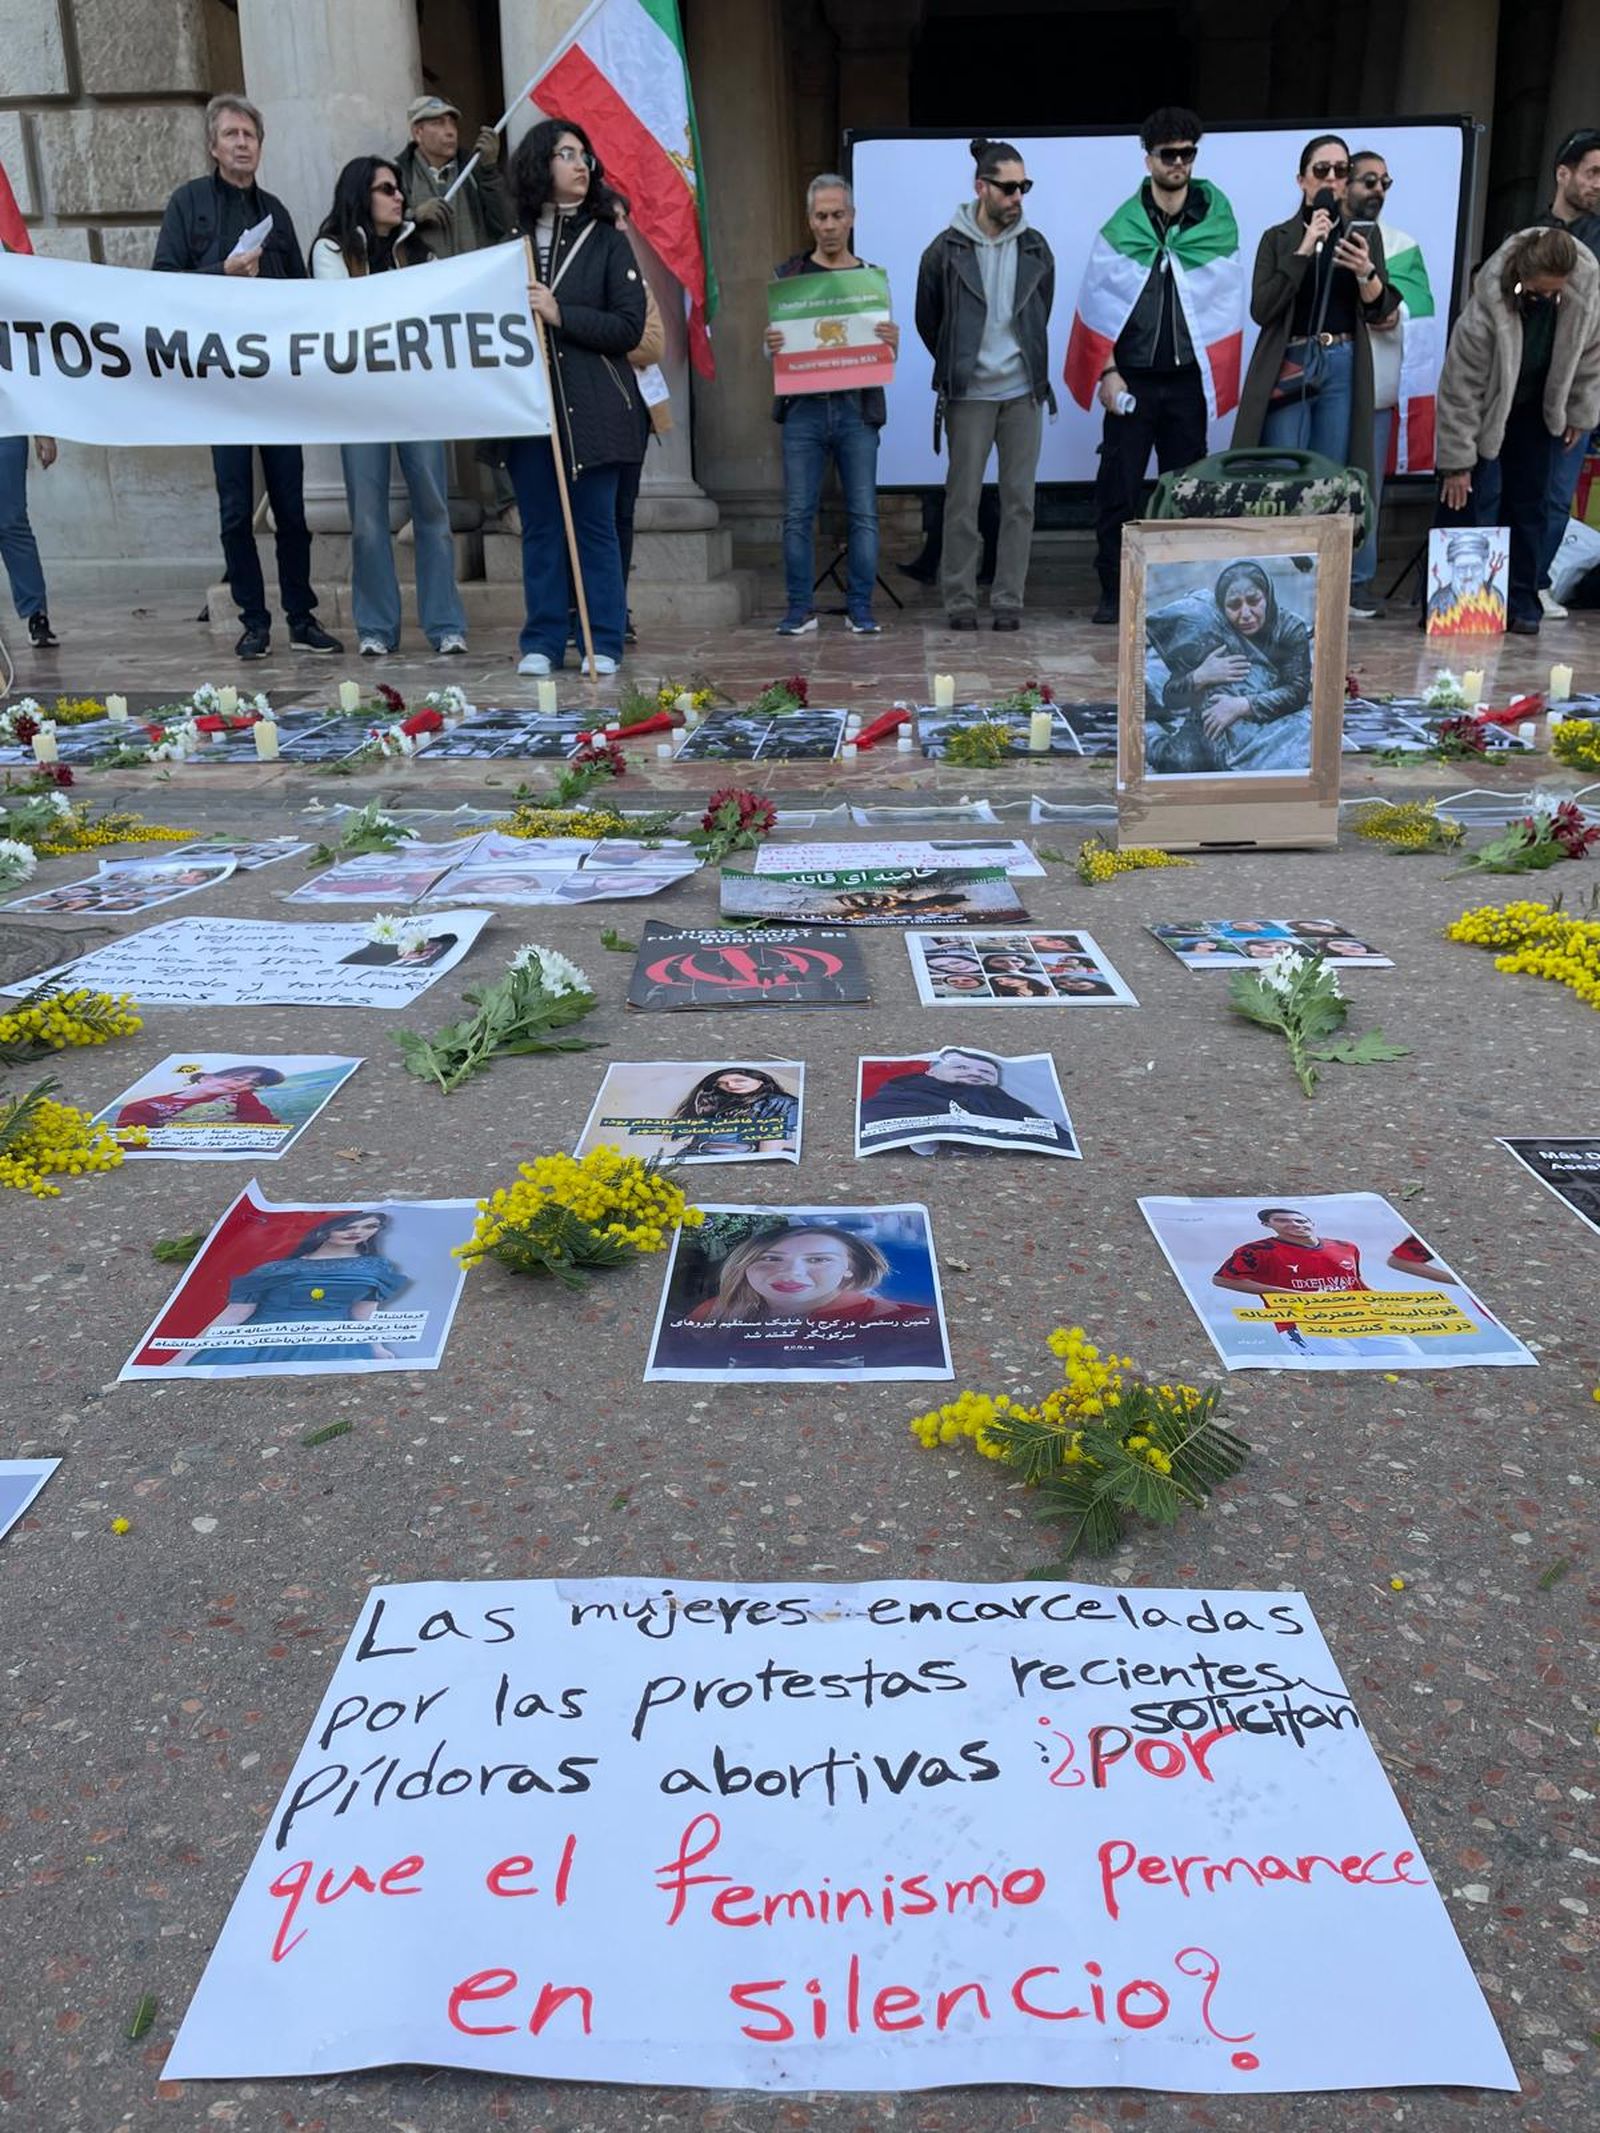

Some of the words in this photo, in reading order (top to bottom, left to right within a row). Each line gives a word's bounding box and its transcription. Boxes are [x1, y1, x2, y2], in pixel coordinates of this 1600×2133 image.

[145, 325, 271, 379] MAS
[289, 312, 535, 377] FUERTES
[700, 937, 795, 945] BURIED?
[158, 944, 179, 952] la
[1362, 1293, 1446, 1303] امیرحسین
[1304, 1311, 1365, 1320] معترض
[1370, 1307, 1458, 1317] فوتبالیست
[670, 1318, 717, 1329] نیروهای
[719, 1318, 763, 1330] مستقیم
[764, 1318, 803, 1329] شلیک
[818, 1318, 841, 1331] کرج
[842, 1320, 856, 1329] در
[859, 1319, 900, 1329] رستمی
[1455, 1322, 1472, 1331] در
[764, 1329, 799, 1339] کشته
[1306, 1326, 1333, 1334] شد
[1338, 1324, 1384, 1334] کشته
[744, 1330, 763, 1340] شد
[803, 1329, 857, 1341] سرکوبگر
[356, 1599, 516, 1662] Las
[868, 1593, 1305, 1635] encarceladas
[319, 1685, 450, 1751] por
[494, 1672, 588, 1727] las
[631, 1658, 968, 1742] protestas
[1130, 1692, 1360, 1749] solicitan
[276, 1739, 599, 1851] píldoras
[659, 1739, 1001, 1807] abortivas
[269, 1854, 426, 1963] que
[485, 1833, 577, 1907] el
[654, 1811, 1046, 1926] feminismo
[448, 1967, 594, 2037] en
